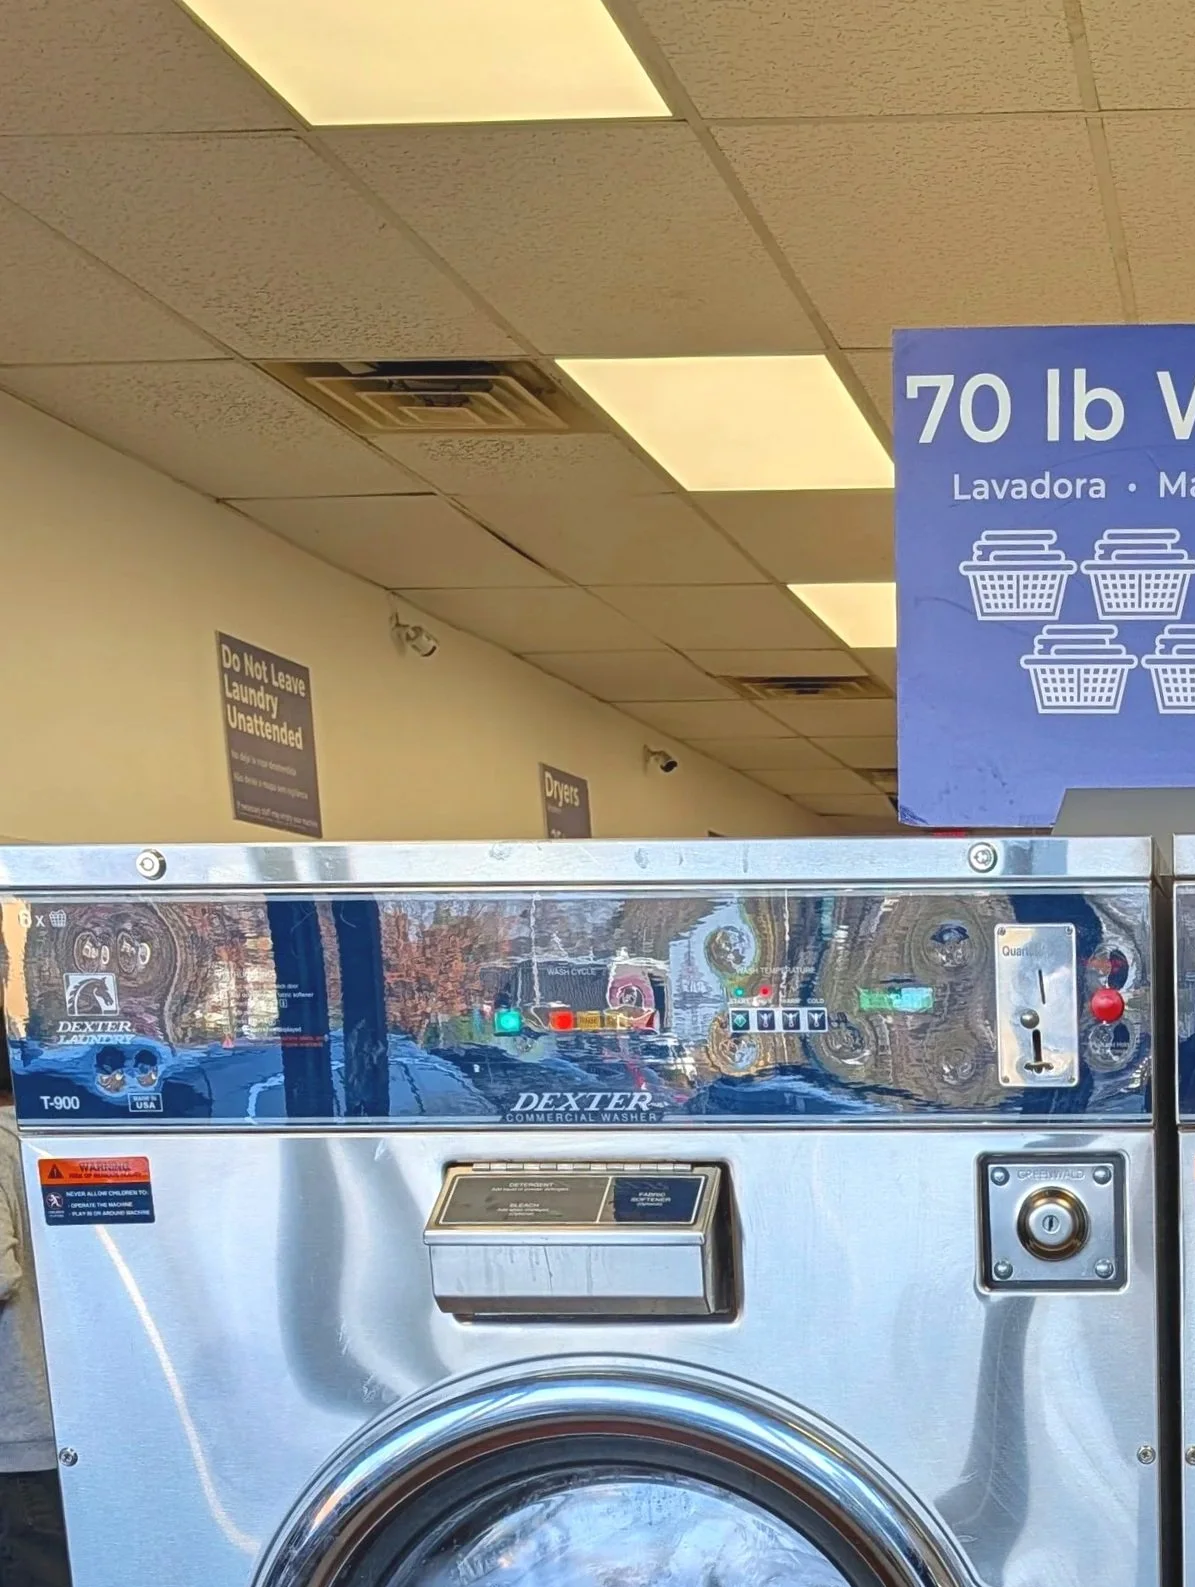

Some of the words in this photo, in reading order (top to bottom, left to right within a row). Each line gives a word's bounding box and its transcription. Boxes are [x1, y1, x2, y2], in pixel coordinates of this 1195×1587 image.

[906, 373, 1012, 444] 70
[1047, 368, 1124, 442] lb
[953, 471, 1106, 500] Lavadora
[221, 644, 241, 672] Do
[244, 652, 268, 684] Not
[271, 663, 306, 698] Leave
[224, 673, 278, 720] Laundry
[227, 704, 303, 750] Unattended
[544, 771, 580, 808] Dryers
[547, 968, 569, 976] WASH
[571, 968, 596, 976] CYCLE
[57, 1021, 132, 1033] DEXTER
[57, 1034, 136, 1045] LAUNDRY
[40, 1096, 80, 1110] T-900
[510, 1092, 652, 1112] DEXTER
[506, 1113, 594, 1122] COMMERCIAL
[601, 1112, 656, 1122] WASHER
[80, 1162, 131, 1172] WARNING
